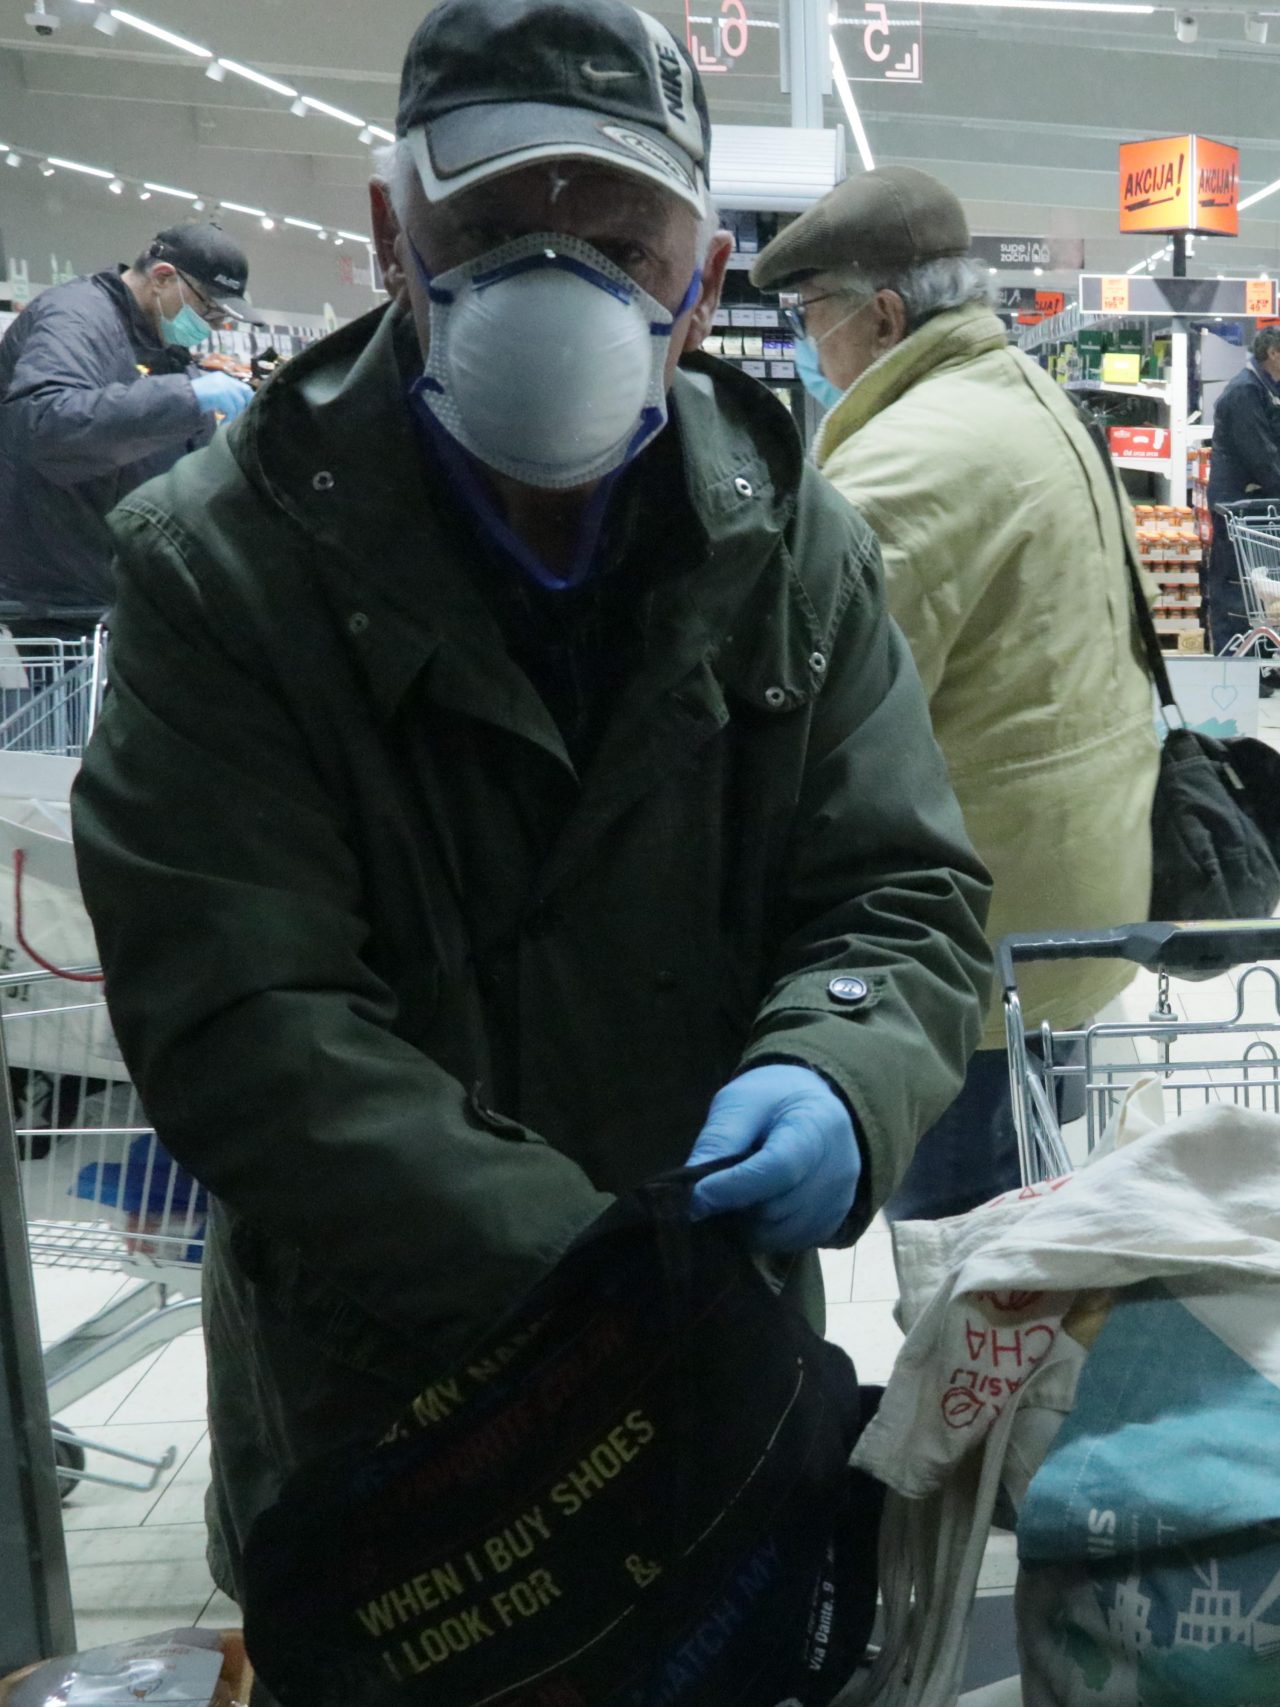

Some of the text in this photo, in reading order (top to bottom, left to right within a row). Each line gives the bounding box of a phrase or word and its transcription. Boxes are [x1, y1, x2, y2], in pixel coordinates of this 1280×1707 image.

[655, 42, 687, 122] NIKE
[1124, 153, 1184, 200] AKCIJA!
[1198, 163, 1235, 204] AKCIJA!
[356, 1561, 463, 1638] WHEN
[483, 1505, 552, 1575] BUY
[548, 1408, 658, 1517] SHOES
[623, 1552, 664, 1588] &
[402, 1612, 493, 1676] LOOK
[490, 1567, 564, 1628] FOR
